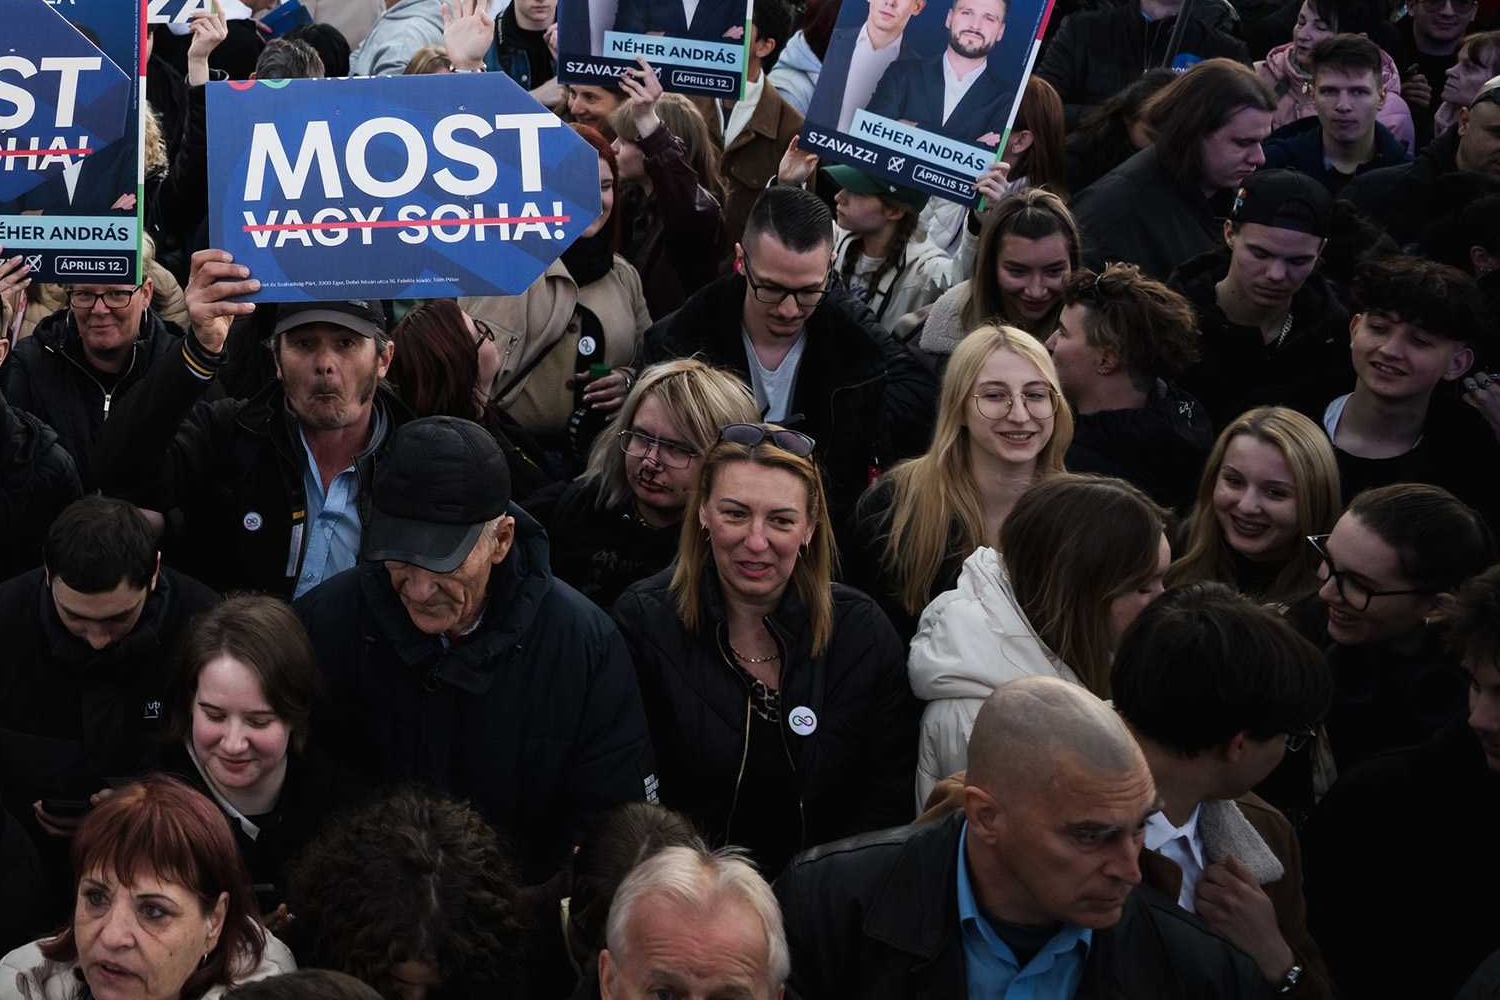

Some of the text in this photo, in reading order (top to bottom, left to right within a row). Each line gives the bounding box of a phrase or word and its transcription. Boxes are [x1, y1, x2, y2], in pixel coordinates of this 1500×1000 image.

[611, 36, 736, 66] NÉHER ANDRÁS
[674, 69, 730, 89] ÁPRILIS 12.
[243, 113, 562, 201] MOST
[807, 131, 879, 165] SZAVAZZ!
[860, 119, 986, 172] NÉHER ANDRÁS
[916, 168, 971, 198] ÁPRILIS 12.
[50, 224, 129, 241] ANDRÁS
[243, 201, 566, 248] VAGY SOHA!
[60, 259, 123, 271] ÁPRILIS 12.
